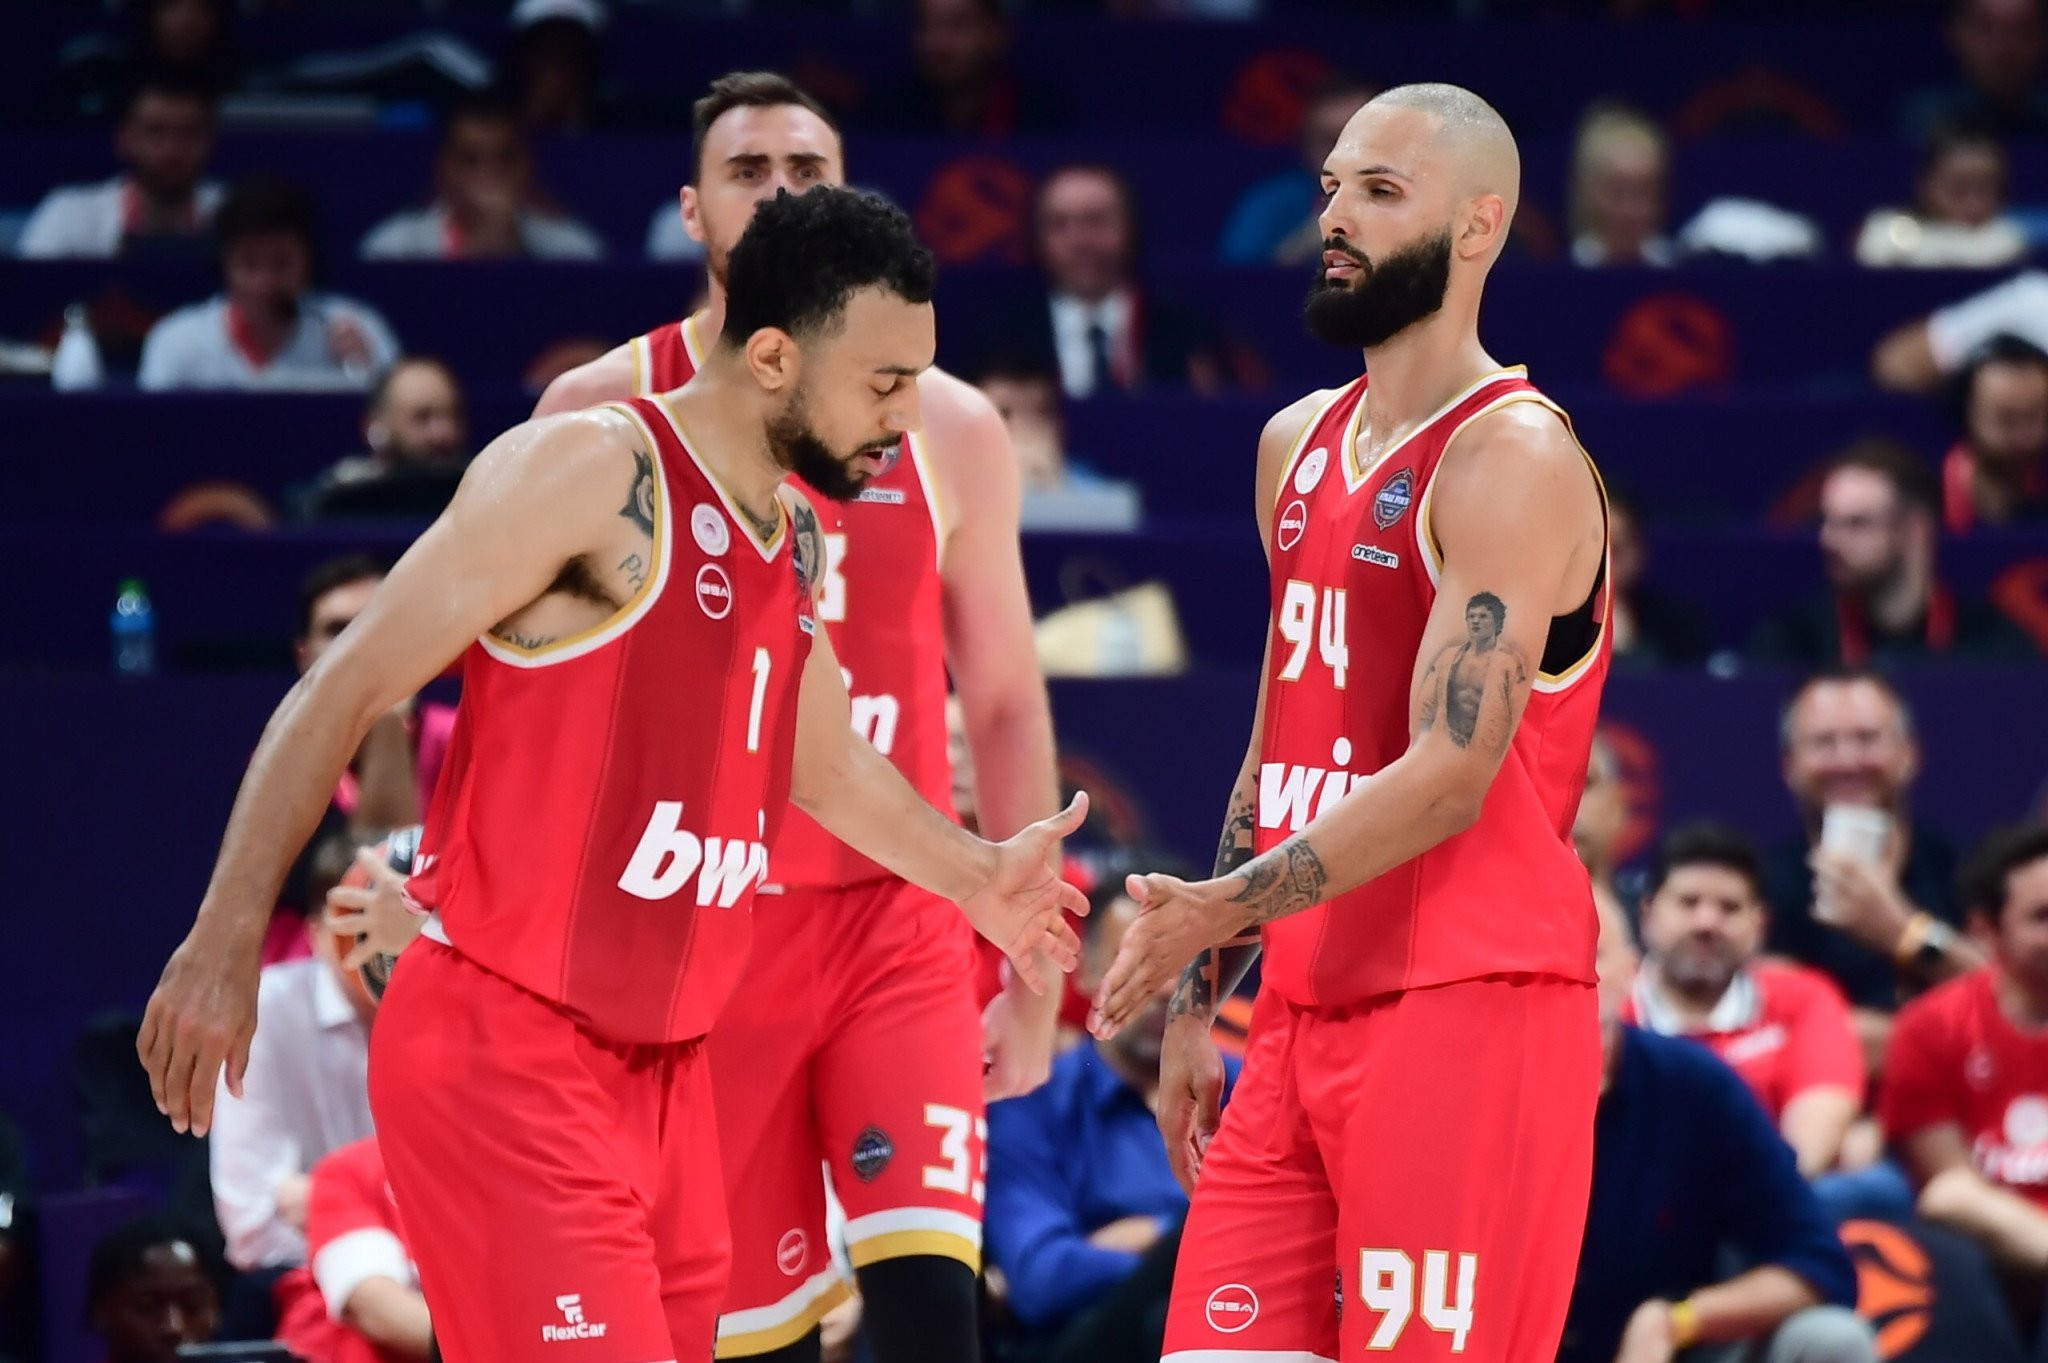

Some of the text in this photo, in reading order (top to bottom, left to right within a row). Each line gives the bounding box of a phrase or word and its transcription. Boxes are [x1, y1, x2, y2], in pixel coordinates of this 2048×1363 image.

[1353, 546, 1397, 567] oneteam
[1277, 579, 1349, 690] 94
[747, 647, 772, 753] 1
[1259, 737, 1373, 831] wi
[542, 1322, 606, 1343] FlexCar
[1210, 1300, 1254, 1313] GSA
[1359, 1247, 1478, 1354] 94
